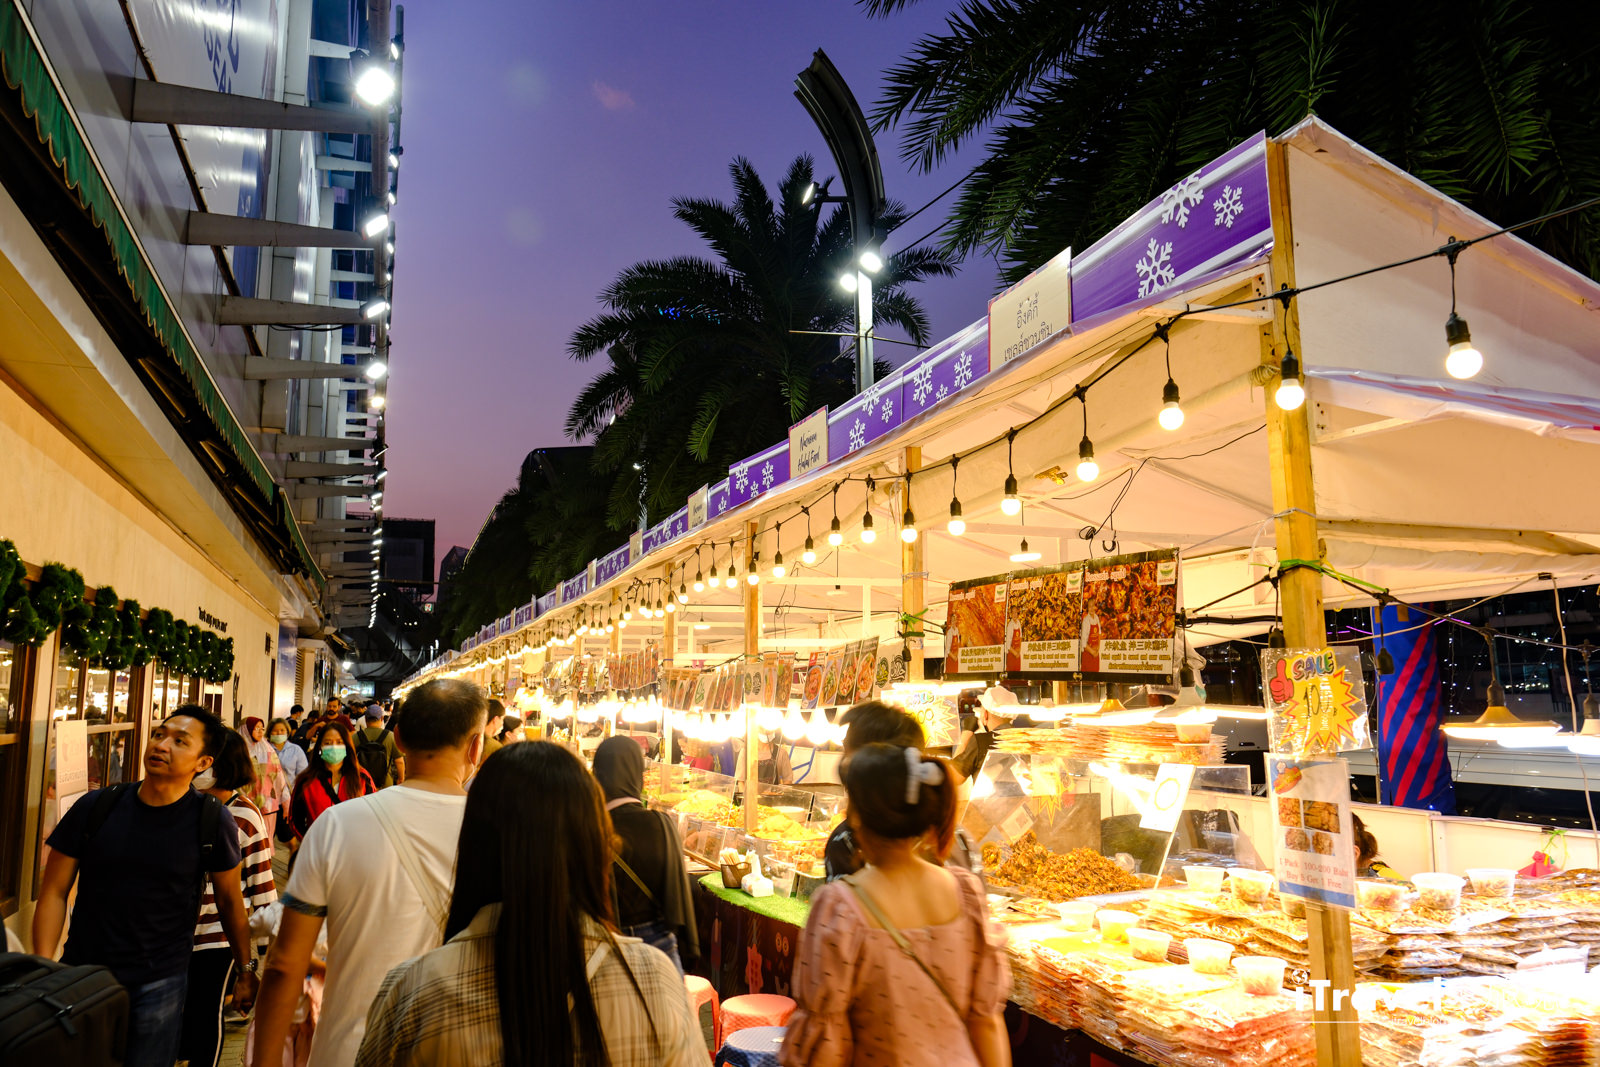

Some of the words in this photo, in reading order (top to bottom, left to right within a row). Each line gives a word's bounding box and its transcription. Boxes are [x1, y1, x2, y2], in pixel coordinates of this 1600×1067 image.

[1292, 652, 1335, 681] SALE
[1284, 857, 1298, 868] Pack
[1303, 862, 1331, 874] 100-200
[1286, 870, 1298, 882] Buy
[1327, 878, 1342, 889] Free
